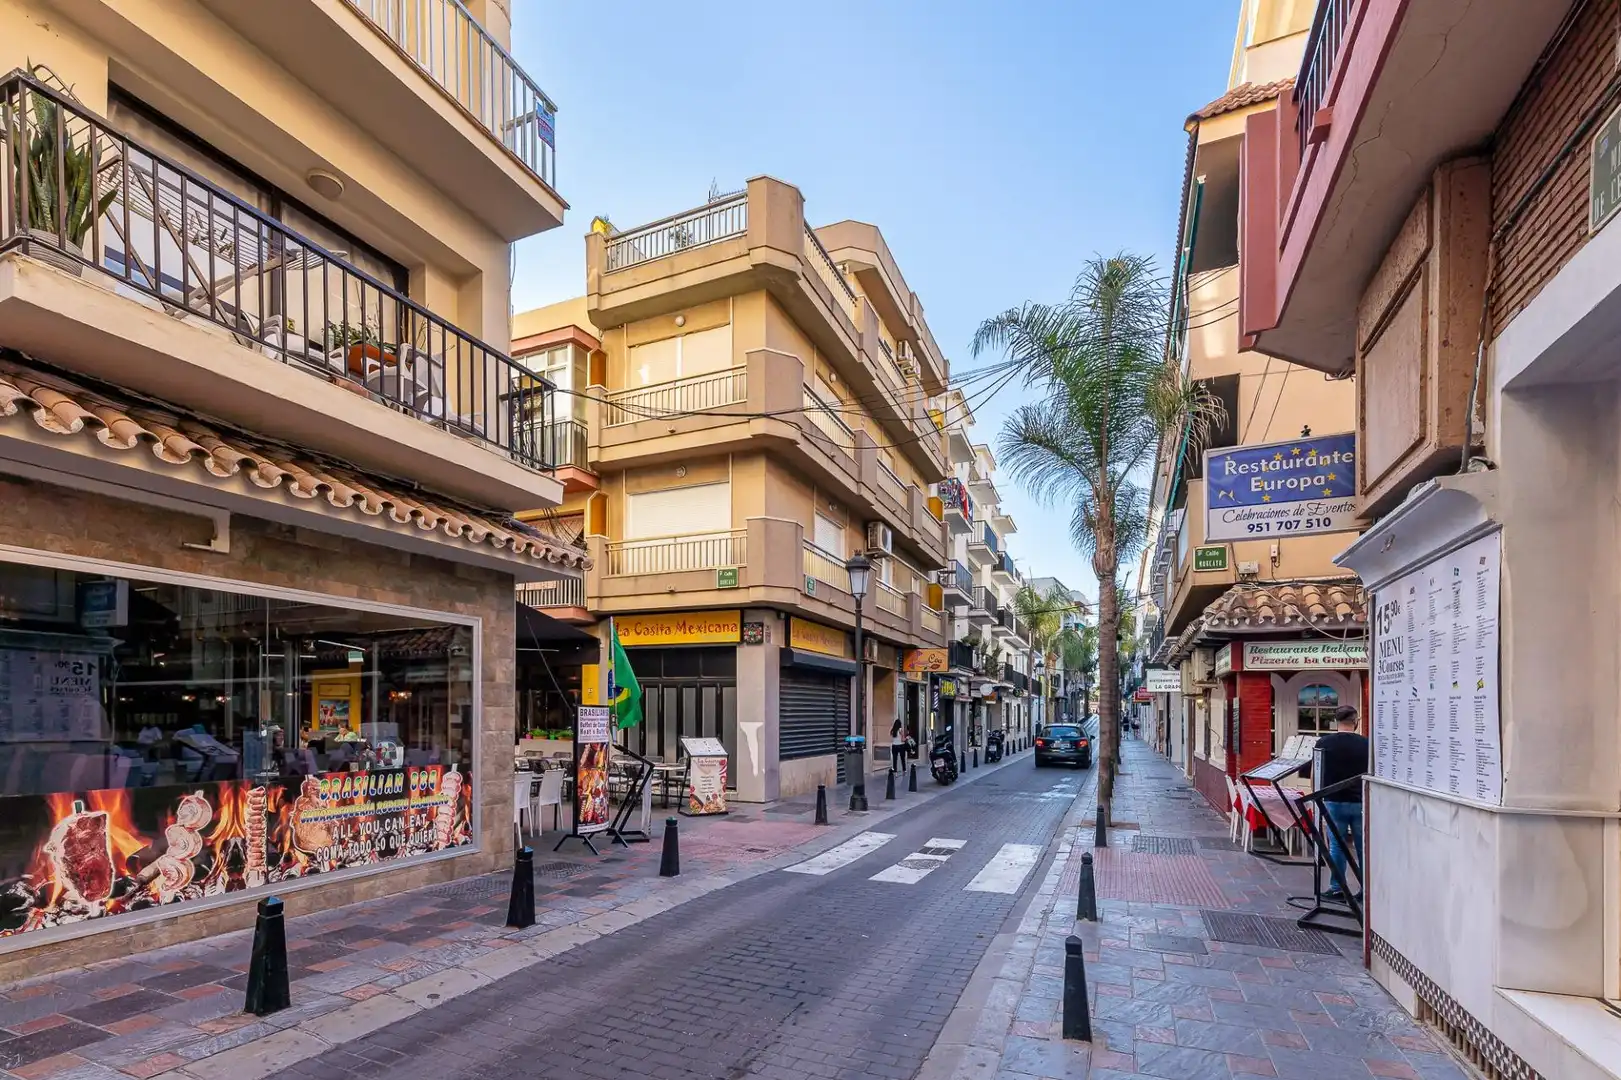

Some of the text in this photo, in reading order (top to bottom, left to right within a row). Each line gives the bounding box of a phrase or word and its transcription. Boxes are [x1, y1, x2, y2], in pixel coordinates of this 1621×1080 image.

[1224, 450, 1354, 476] Restaurante
[1250, 474, 1326, 492] Europa
[1222, 501, 1356, 523] Celebraciones de Eventos
[1247, 517, 1332, 533] 951 707 510
[615, 620, 738, 637] La Casita Mexicana
[1250, 643, 1369, 654] Restaurante Italiano
[1379, 636, 1404, 658] MENU
[1304, 656, 1318, 664] La
[1323, 656, 1368, 666] Grappa
[319, 774, 404, 800] BRASILIAN
[332, 813, 427, 840] ALL YOU CAN EAT
[316, 828, 438, 862] COMA TODO LO QUE QUIERA
